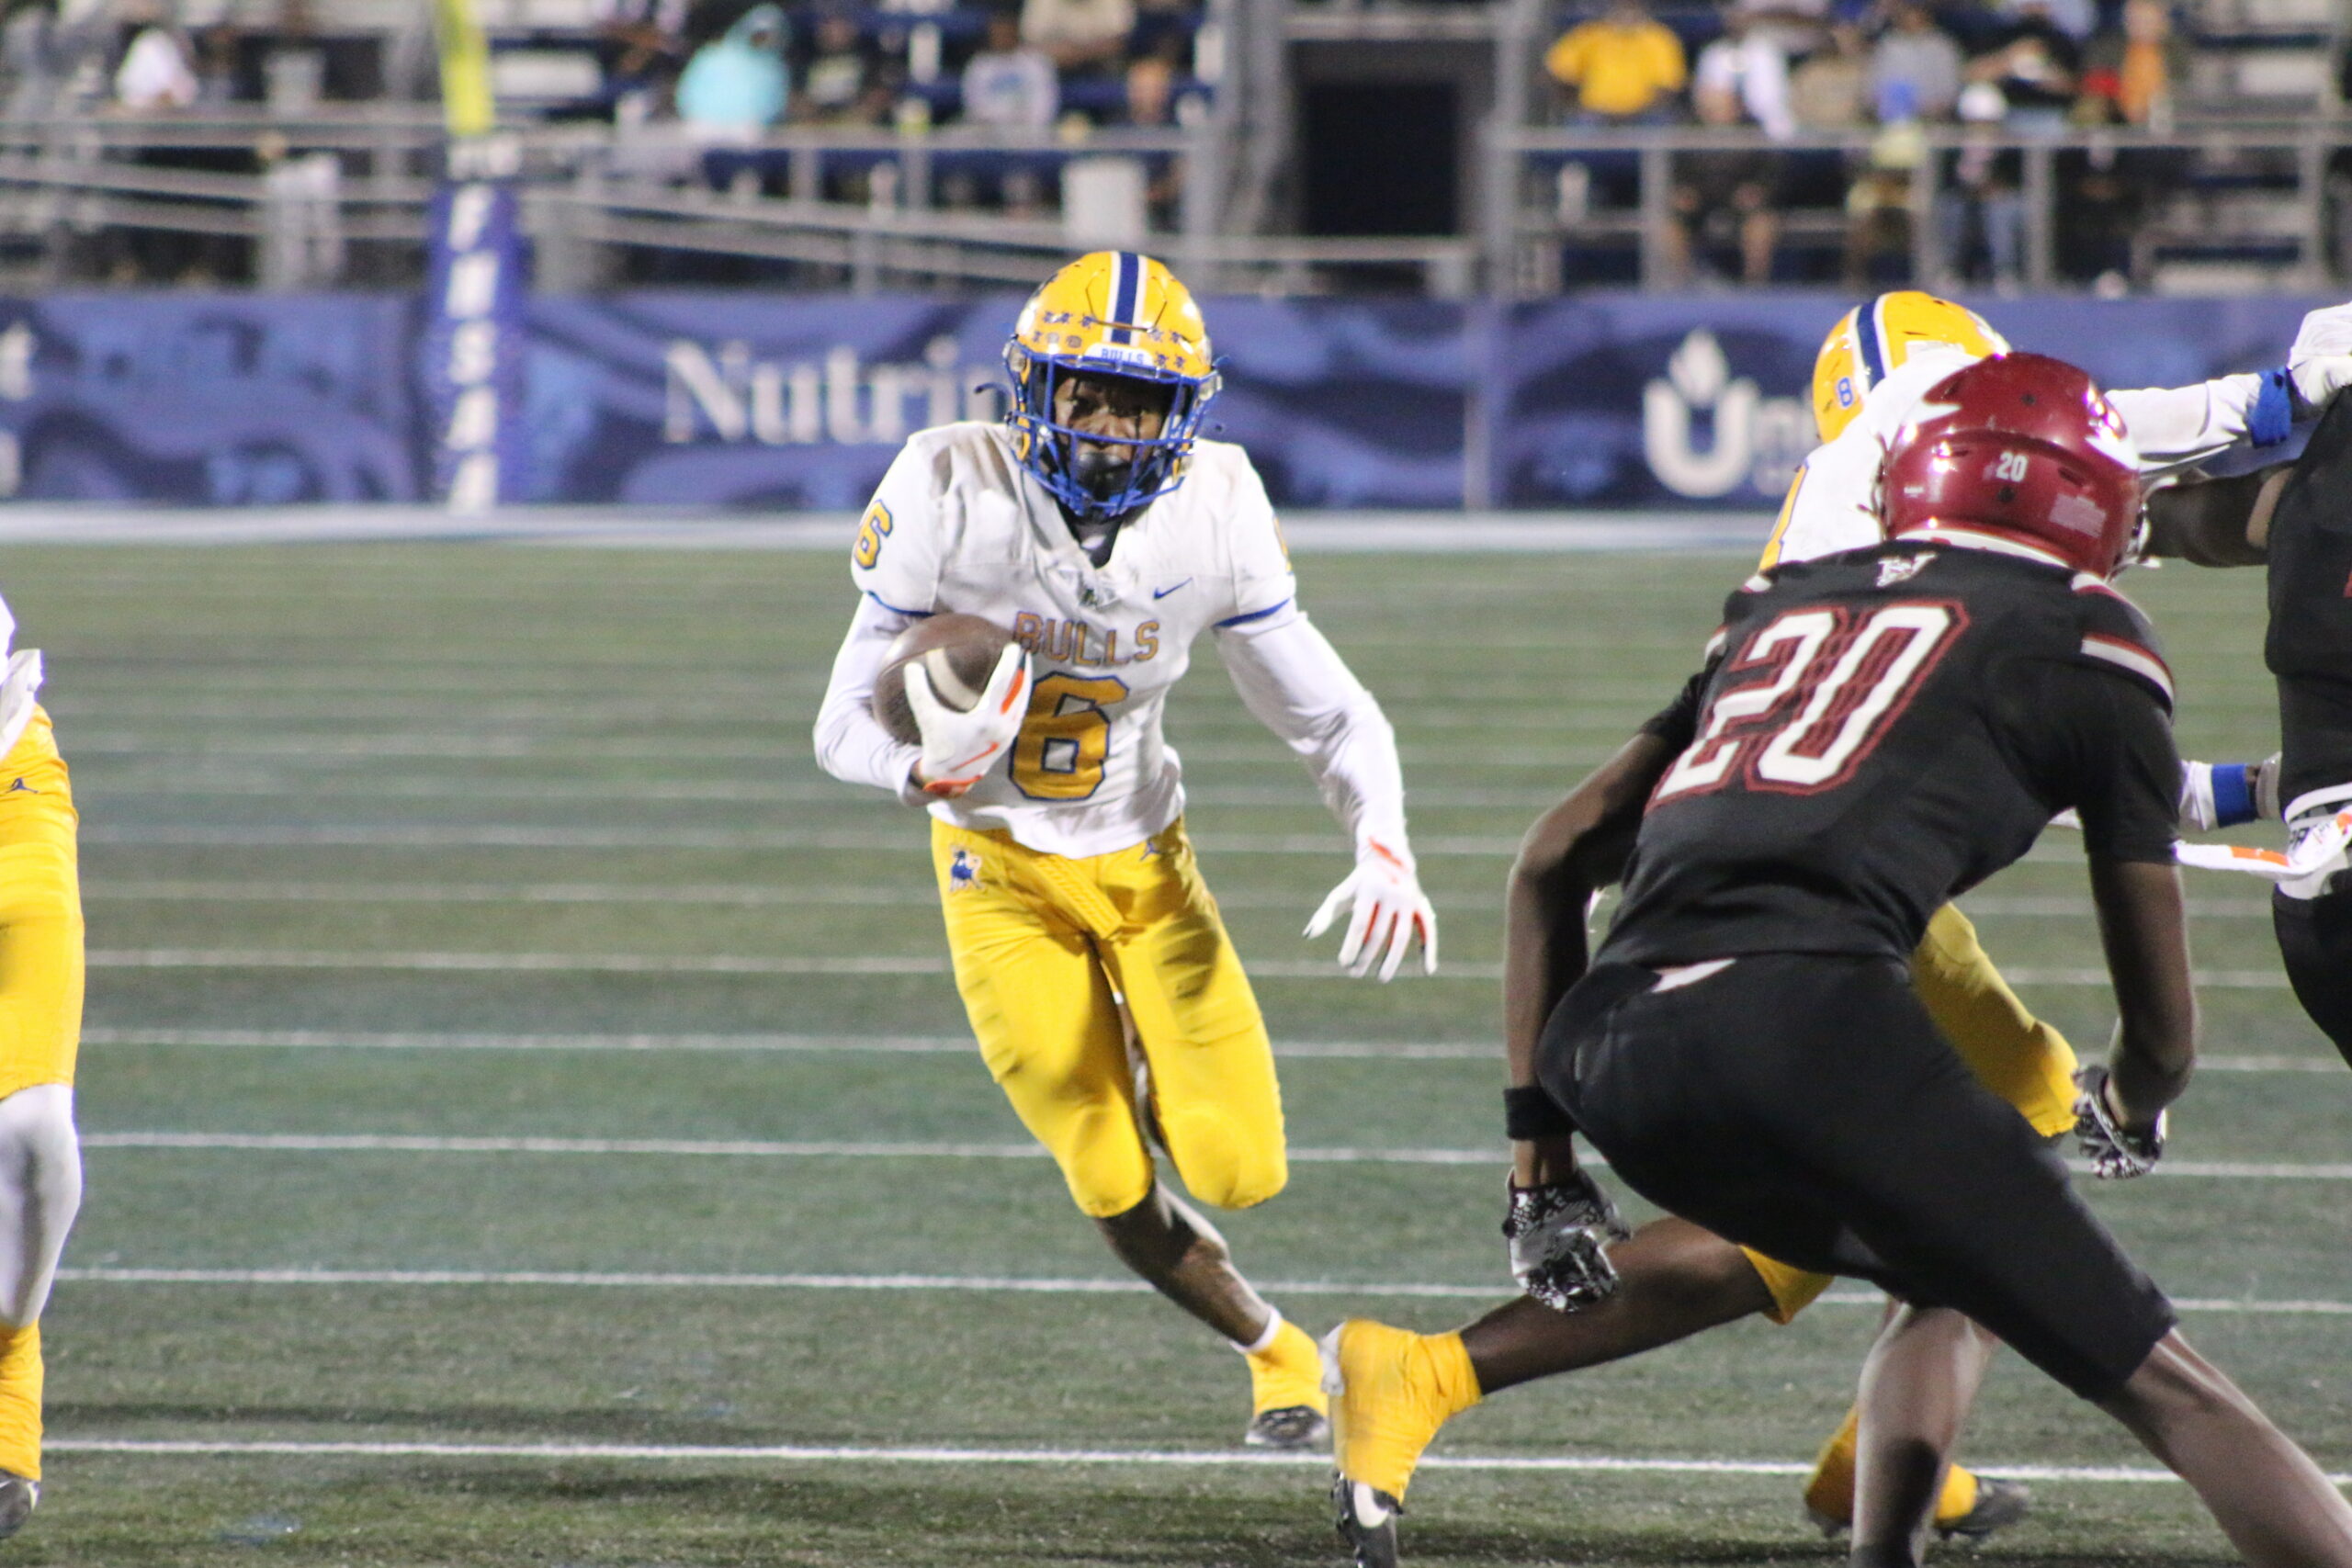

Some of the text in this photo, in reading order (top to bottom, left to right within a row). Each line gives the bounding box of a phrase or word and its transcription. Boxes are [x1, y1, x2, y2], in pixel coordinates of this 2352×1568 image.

[1101, 348, 1144, 365] BULLS
[1996, 452, 2028, 482] 20
[854, 499, 893, 570] 6
[1014, 611, 1159, 666] BULLS
[1008, 671, 1130, 802] 6
[1645, 599, 1970, 813] 20
